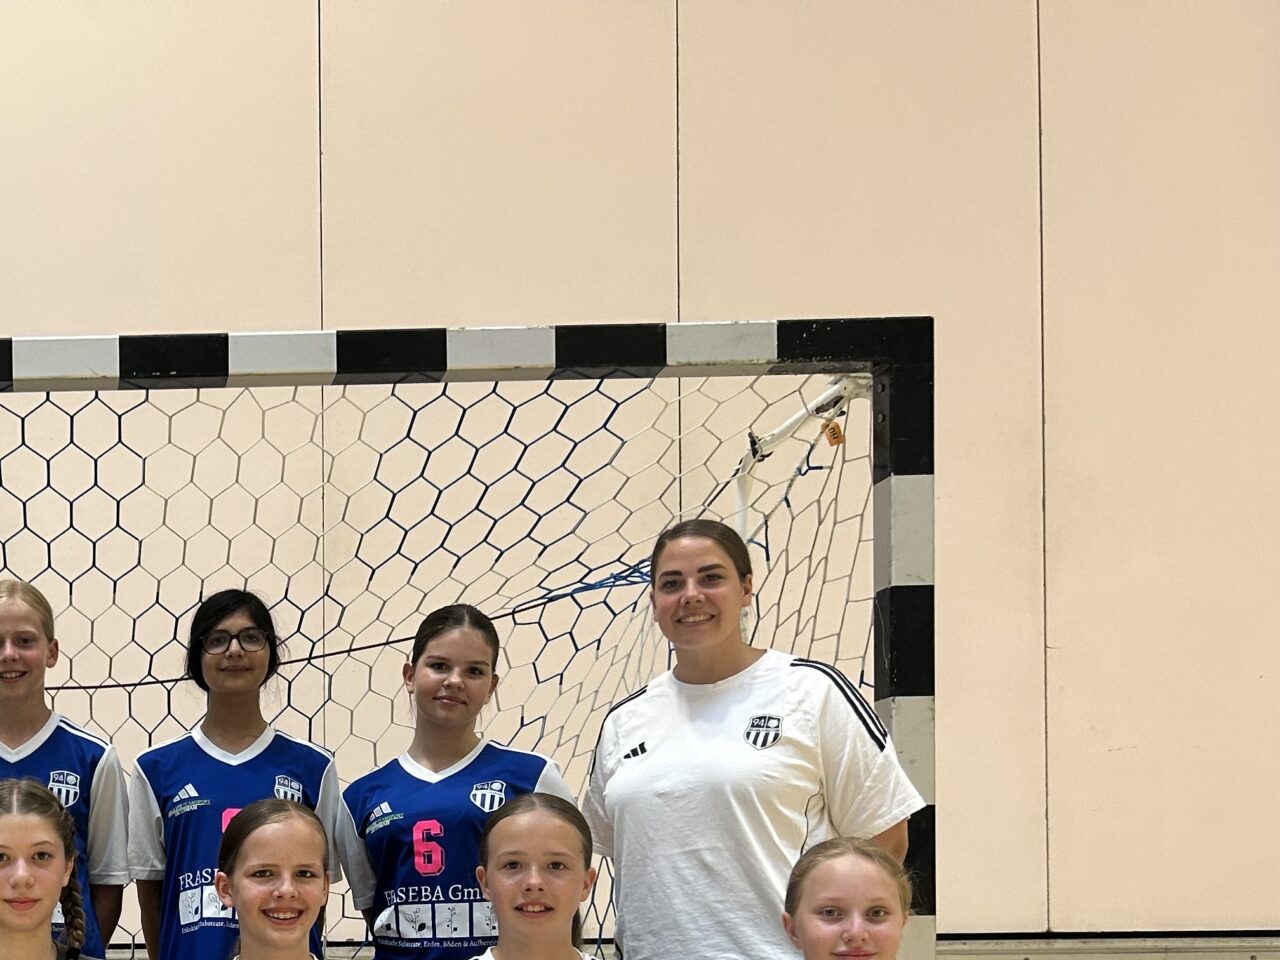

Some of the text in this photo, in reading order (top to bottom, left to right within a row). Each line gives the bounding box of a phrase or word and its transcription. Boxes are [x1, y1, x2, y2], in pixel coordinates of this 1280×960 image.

[752, 719, 766, 727] 94
[52, 773, 64, 782] 94
[278, 777, 289, 786] 94
[413, 819, 445, 877] 6
[178, 868, 219, 891] FRAS
[384, 885, 486, 905] FASEBA Gm
